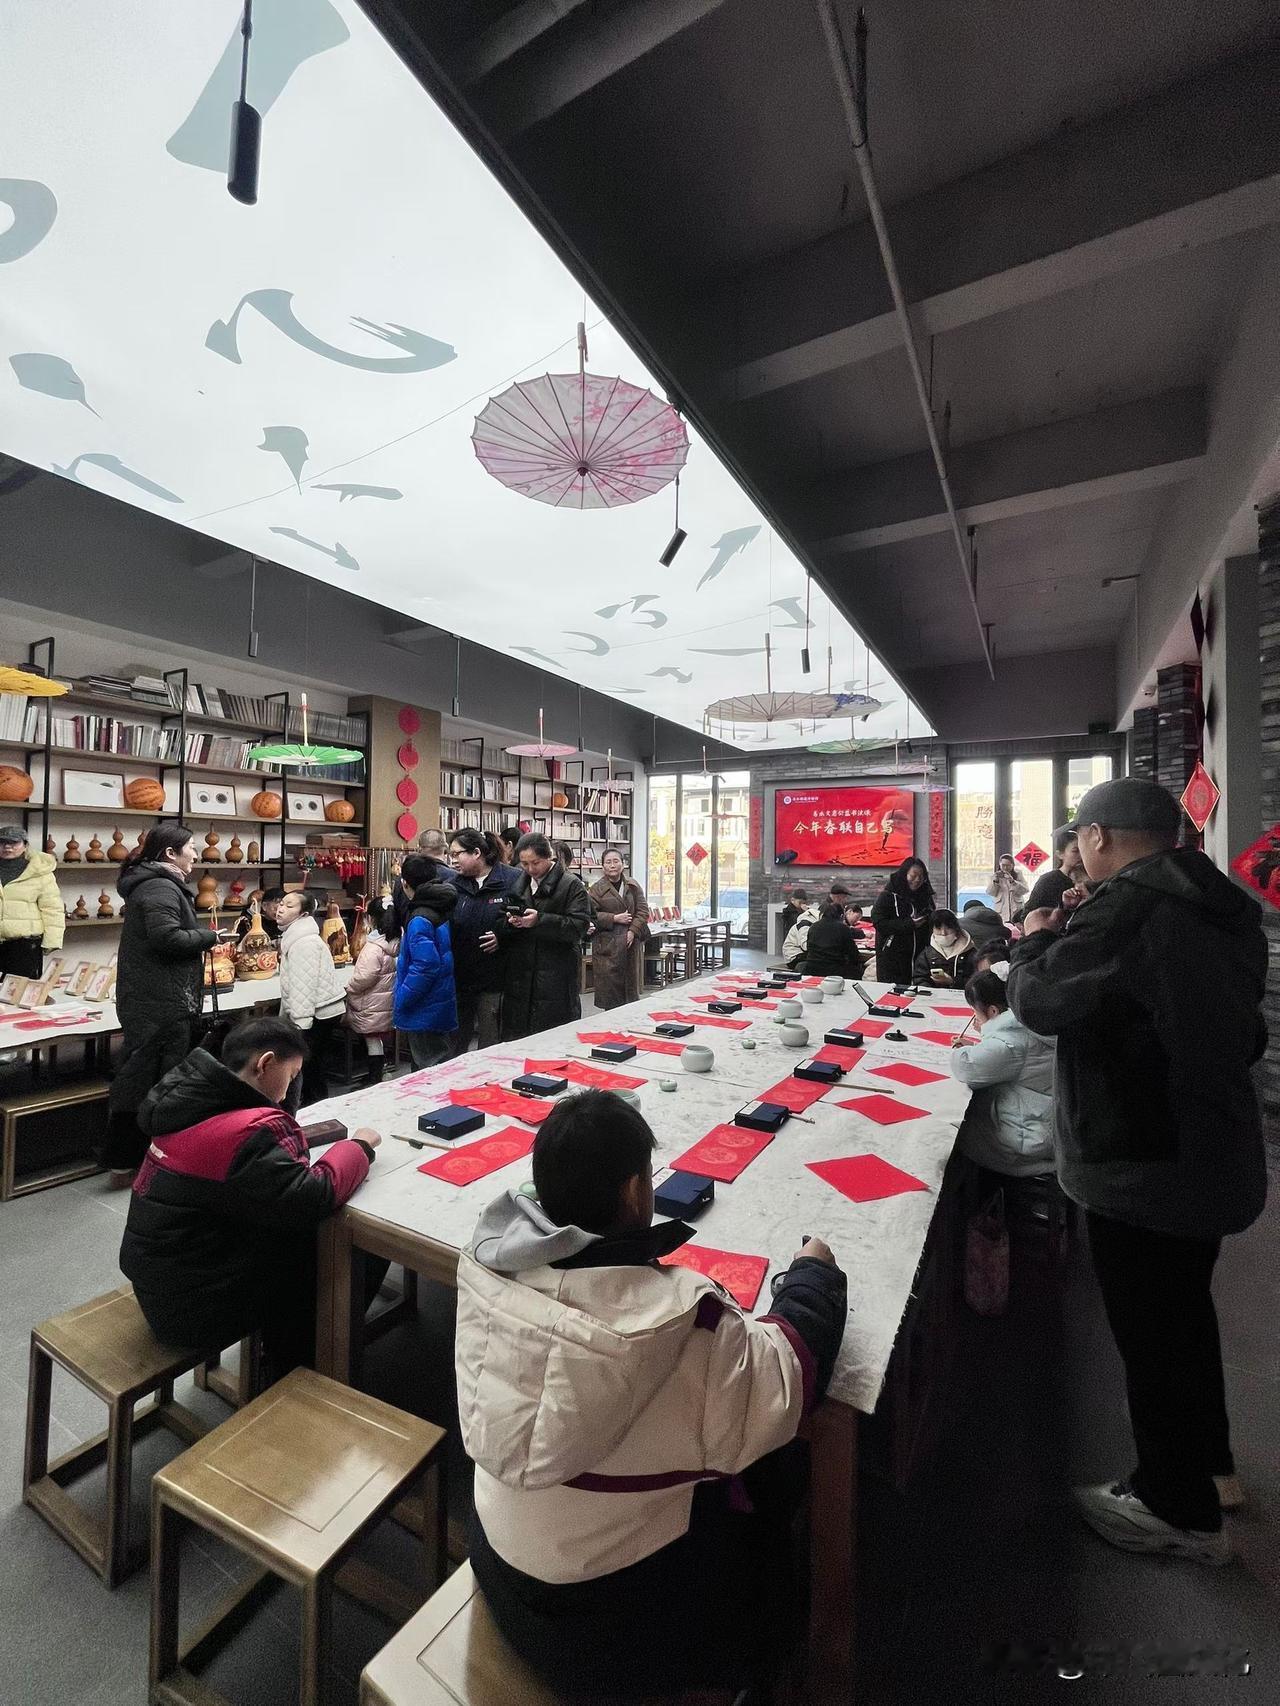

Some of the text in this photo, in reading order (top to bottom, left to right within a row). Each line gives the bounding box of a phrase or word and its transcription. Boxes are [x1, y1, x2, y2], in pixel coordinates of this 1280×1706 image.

[792, 818, 894, 837] 今年春联自己写
[1023, 848, 1042, 867] 福
